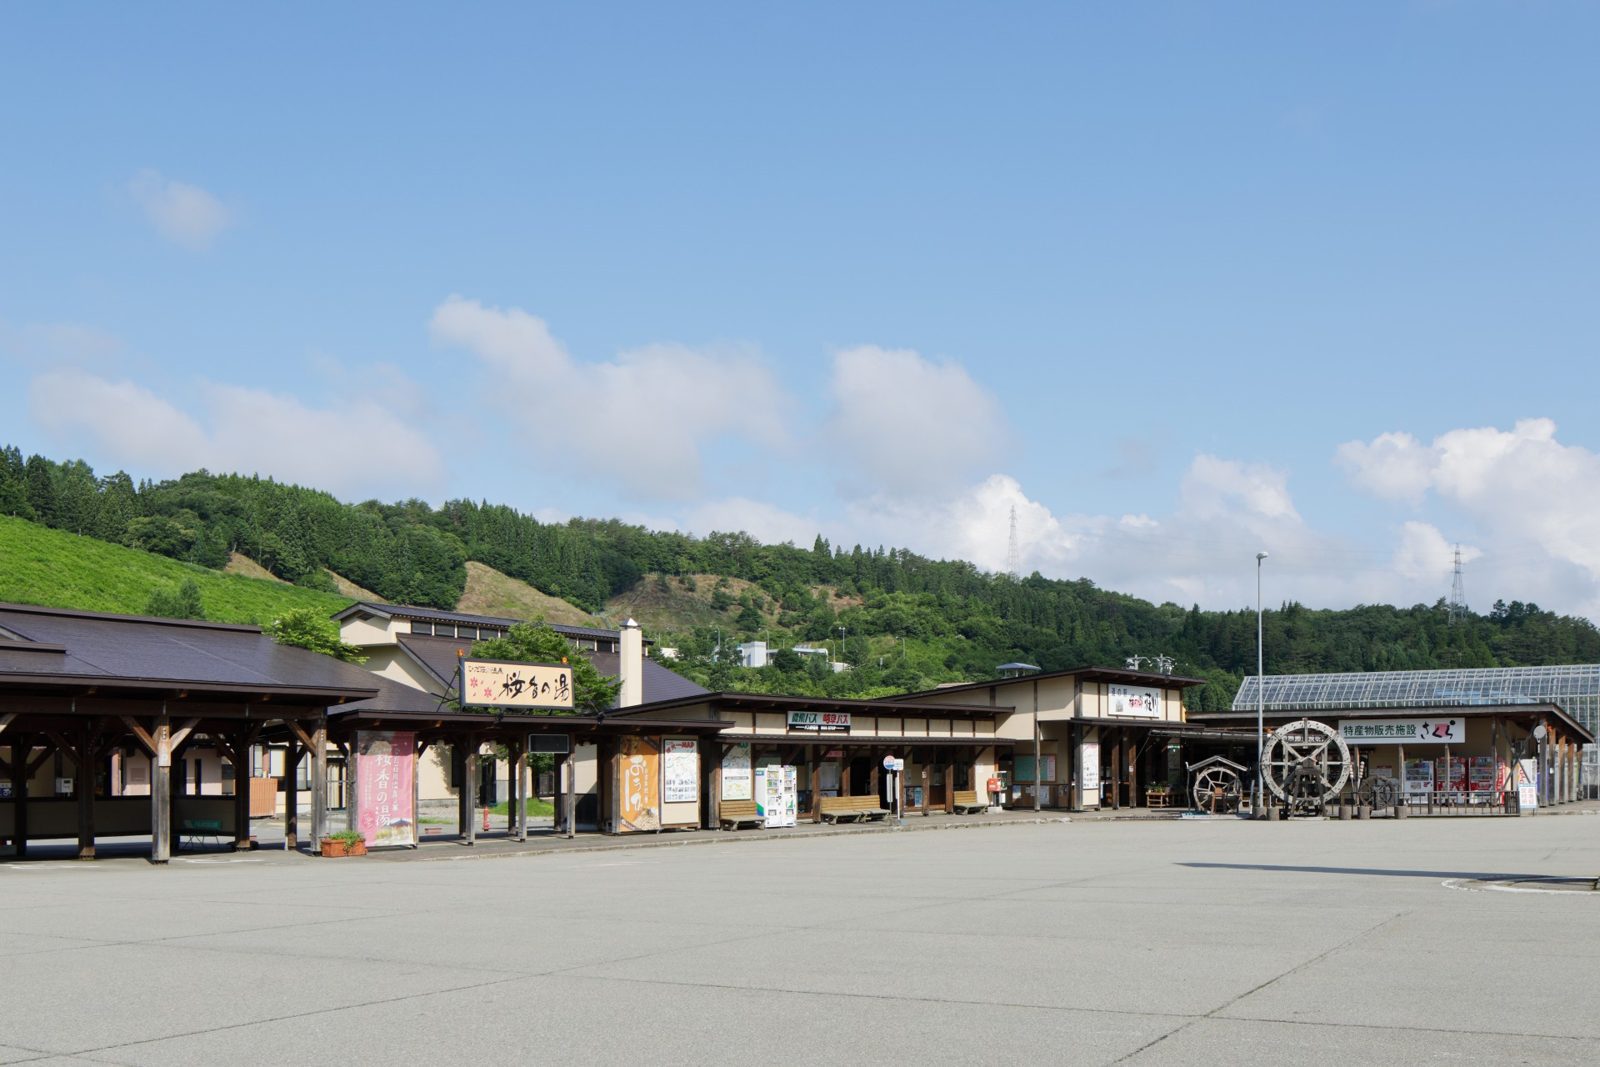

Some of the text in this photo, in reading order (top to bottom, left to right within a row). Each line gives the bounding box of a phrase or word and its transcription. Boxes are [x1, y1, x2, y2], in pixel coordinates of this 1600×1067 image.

[1343, 724, 1417, 736] 特産物販売施設
[1420, 720, 1456, 740] さくら
